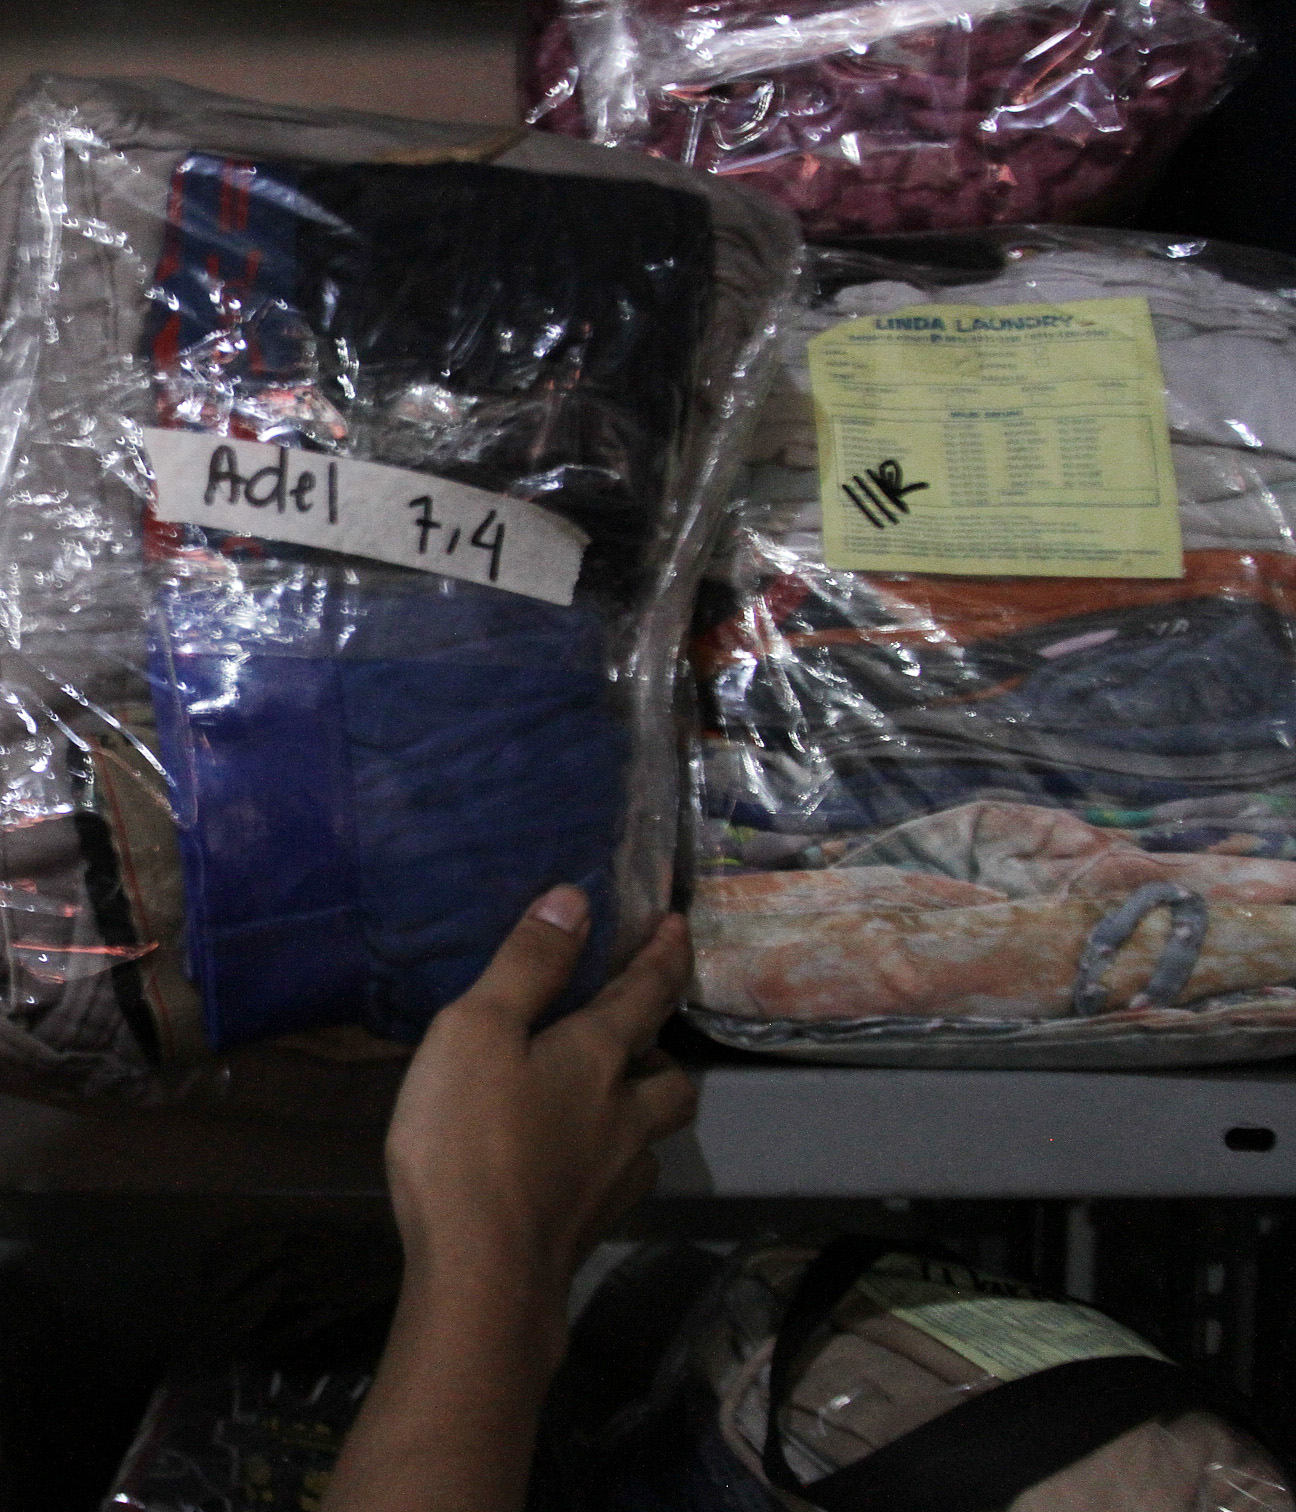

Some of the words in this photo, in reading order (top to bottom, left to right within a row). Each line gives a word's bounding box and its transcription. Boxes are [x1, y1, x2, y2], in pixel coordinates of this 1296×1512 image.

[875, 317, 946, 331] LINDA
[955, 315, 1074, 332] LAUNDRY
[204, 444, 339, 525] Adel
[408, 494, 505, 582] 7,4
